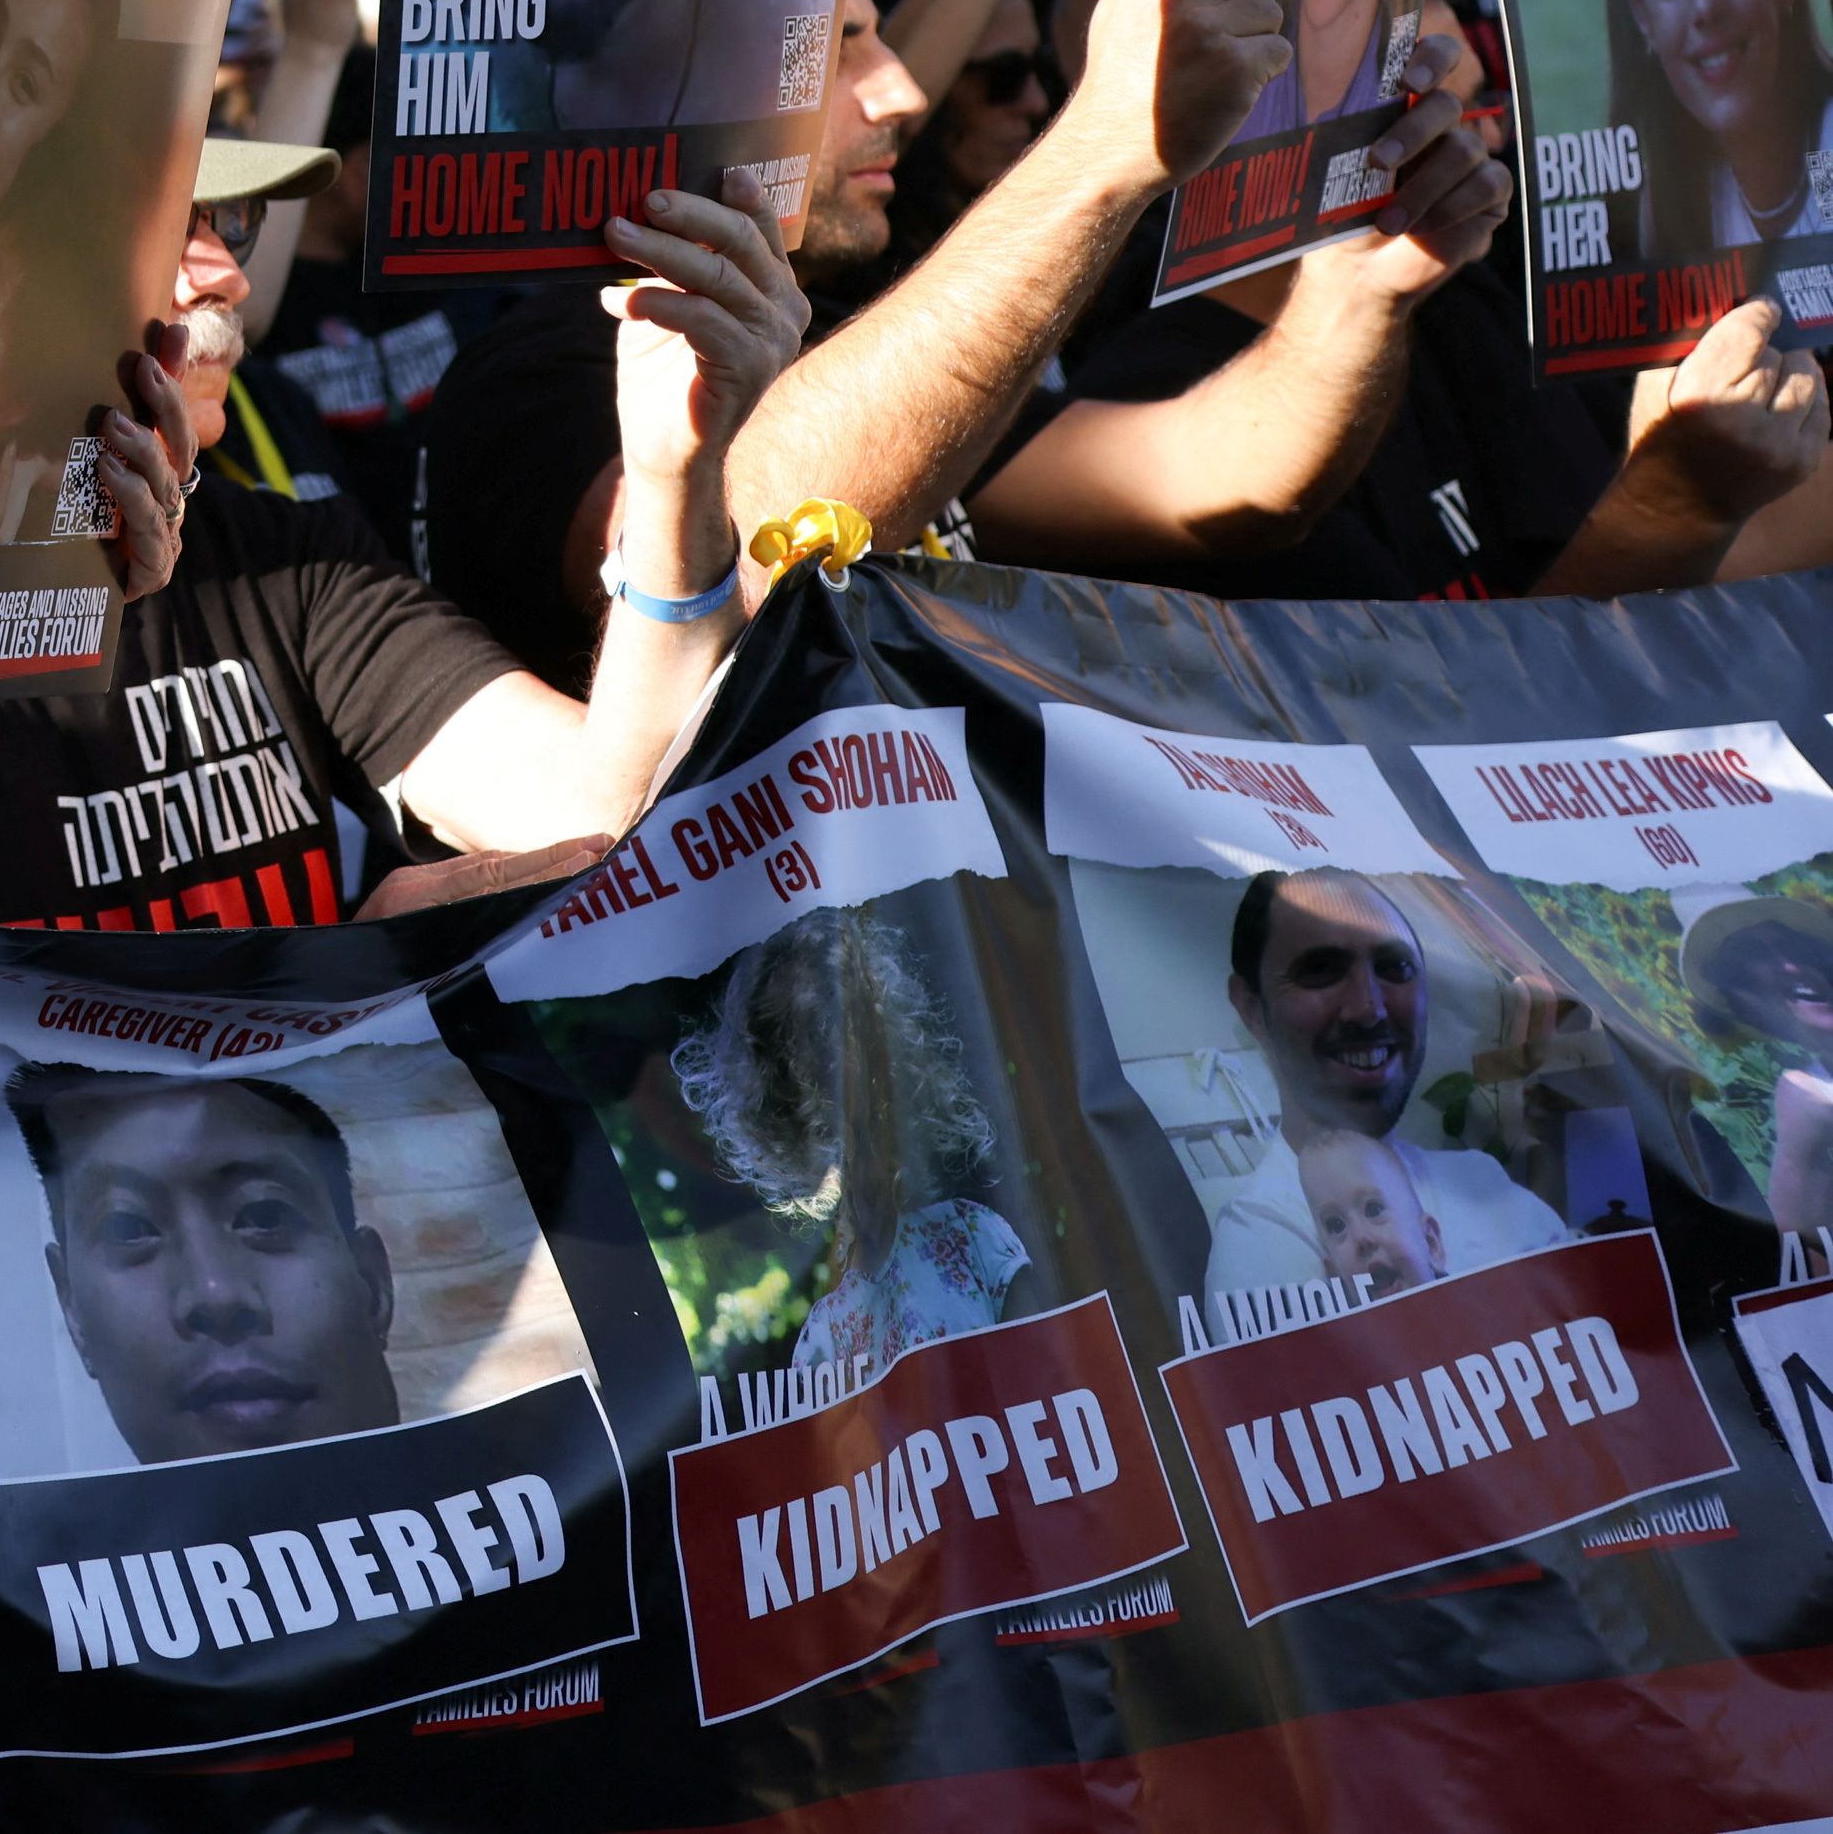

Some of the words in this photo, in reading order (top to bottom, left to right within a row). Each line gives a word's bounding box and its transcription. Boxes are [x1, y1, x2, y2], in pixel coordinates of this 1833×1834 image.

[395, 51, 490, 137] HIM
[390, 151, 529, 238] HOME
[1174, 157, 1244, 254] HOME
[1236, 131, 1314, 233] NOW!
[1536, 125, 1641, 201] BRING
[1540, 204, 1613, 272] HER
[1546, 269, 1646, 349] HOME
[28, 591, 55, 618] AND
[56, 587, 108, 616] MISSING
[39, 616, 104, 657] FORUM
[1141, 735, 1231, 793] TAL
[1476, 762, 1591, 824] LILACH
[1584, 759, 1655, 817] LEA
[1649, 747, 1775, 810] KIPNIS
[670, 775, 795, 881] GANI
[788, 730, 957, 813] SHOHAM
[765, 843, 821, 902] (3)
[1632, 822, 1702, 869] (60)
[38, 994, 212, 1053] CAREGIVER
[1178, 1295, 1208, 1357] A
[700, 1375, 728, 1443] A
[1226, 1316, 1640, 1523] KIDNAPPED
[737, 1388, 1119, 1620] KIDNAPPED
[37, 1474, 566, 1673] MURDERED
[1108, 1576, 1175, 1623] FORUM
[524, 1662, 600, 1710] FORUM
